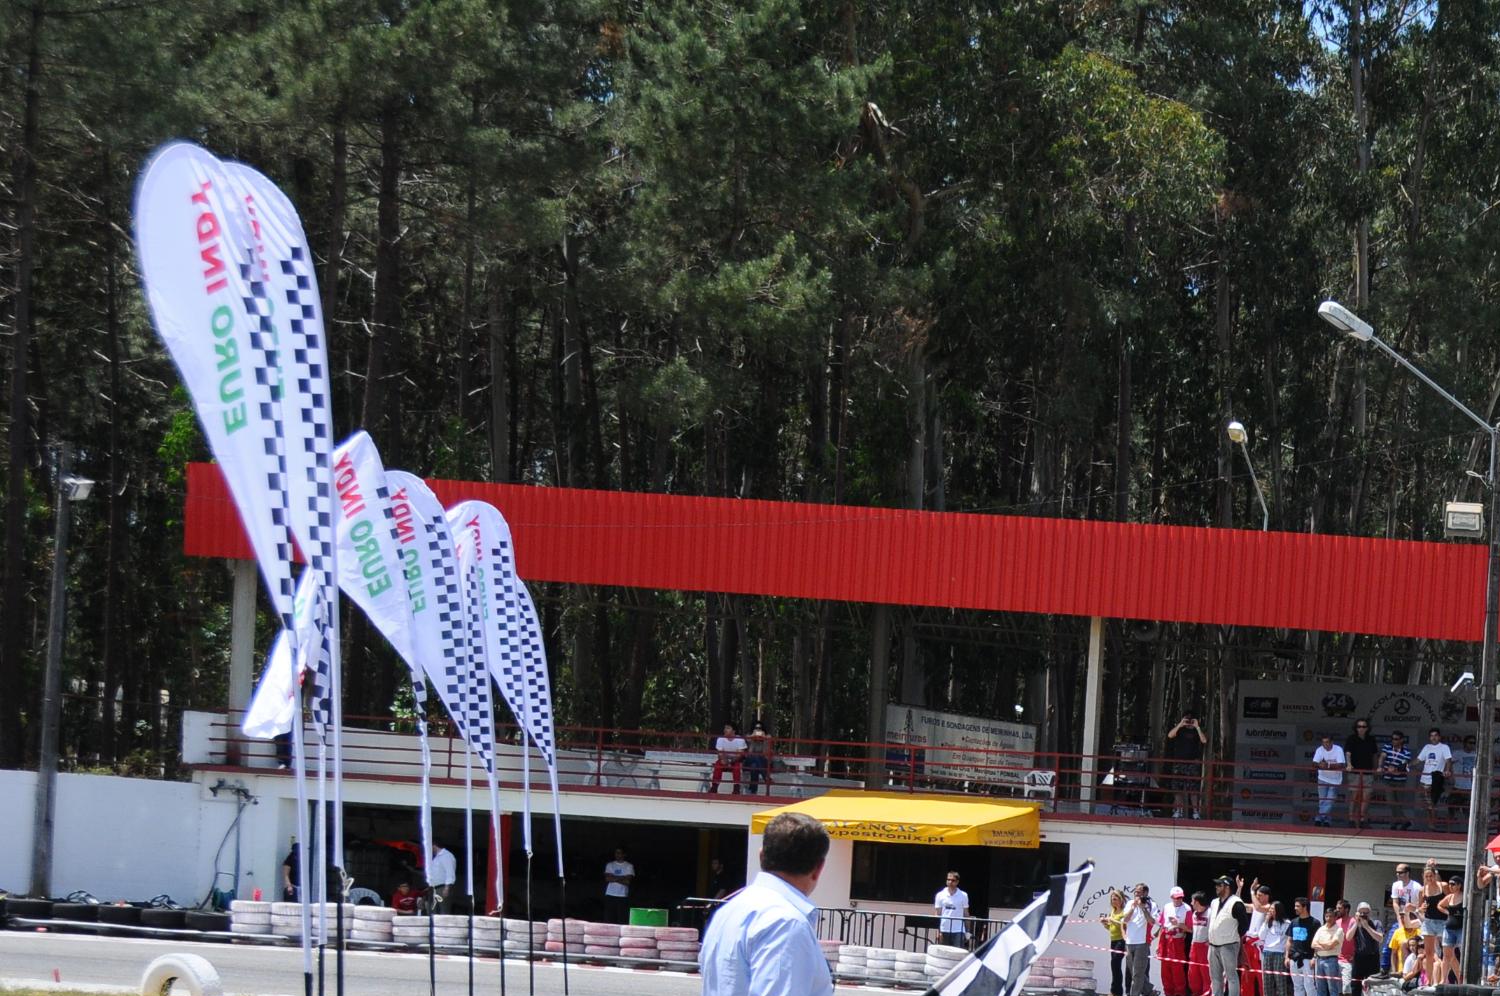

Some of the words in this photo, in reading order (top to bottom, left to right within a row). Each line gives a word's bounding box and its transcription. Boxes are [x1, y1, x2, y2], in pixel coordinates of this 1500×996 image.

[1328, 694, 1347, 707] 24
[921, 715, 941, 727] FUROS
[946, 721, 981, 733] SONDAGENS
[826, 821, 918, 833] ALANÇAS
[1078, 886, 1115, 919] ESCOLA
